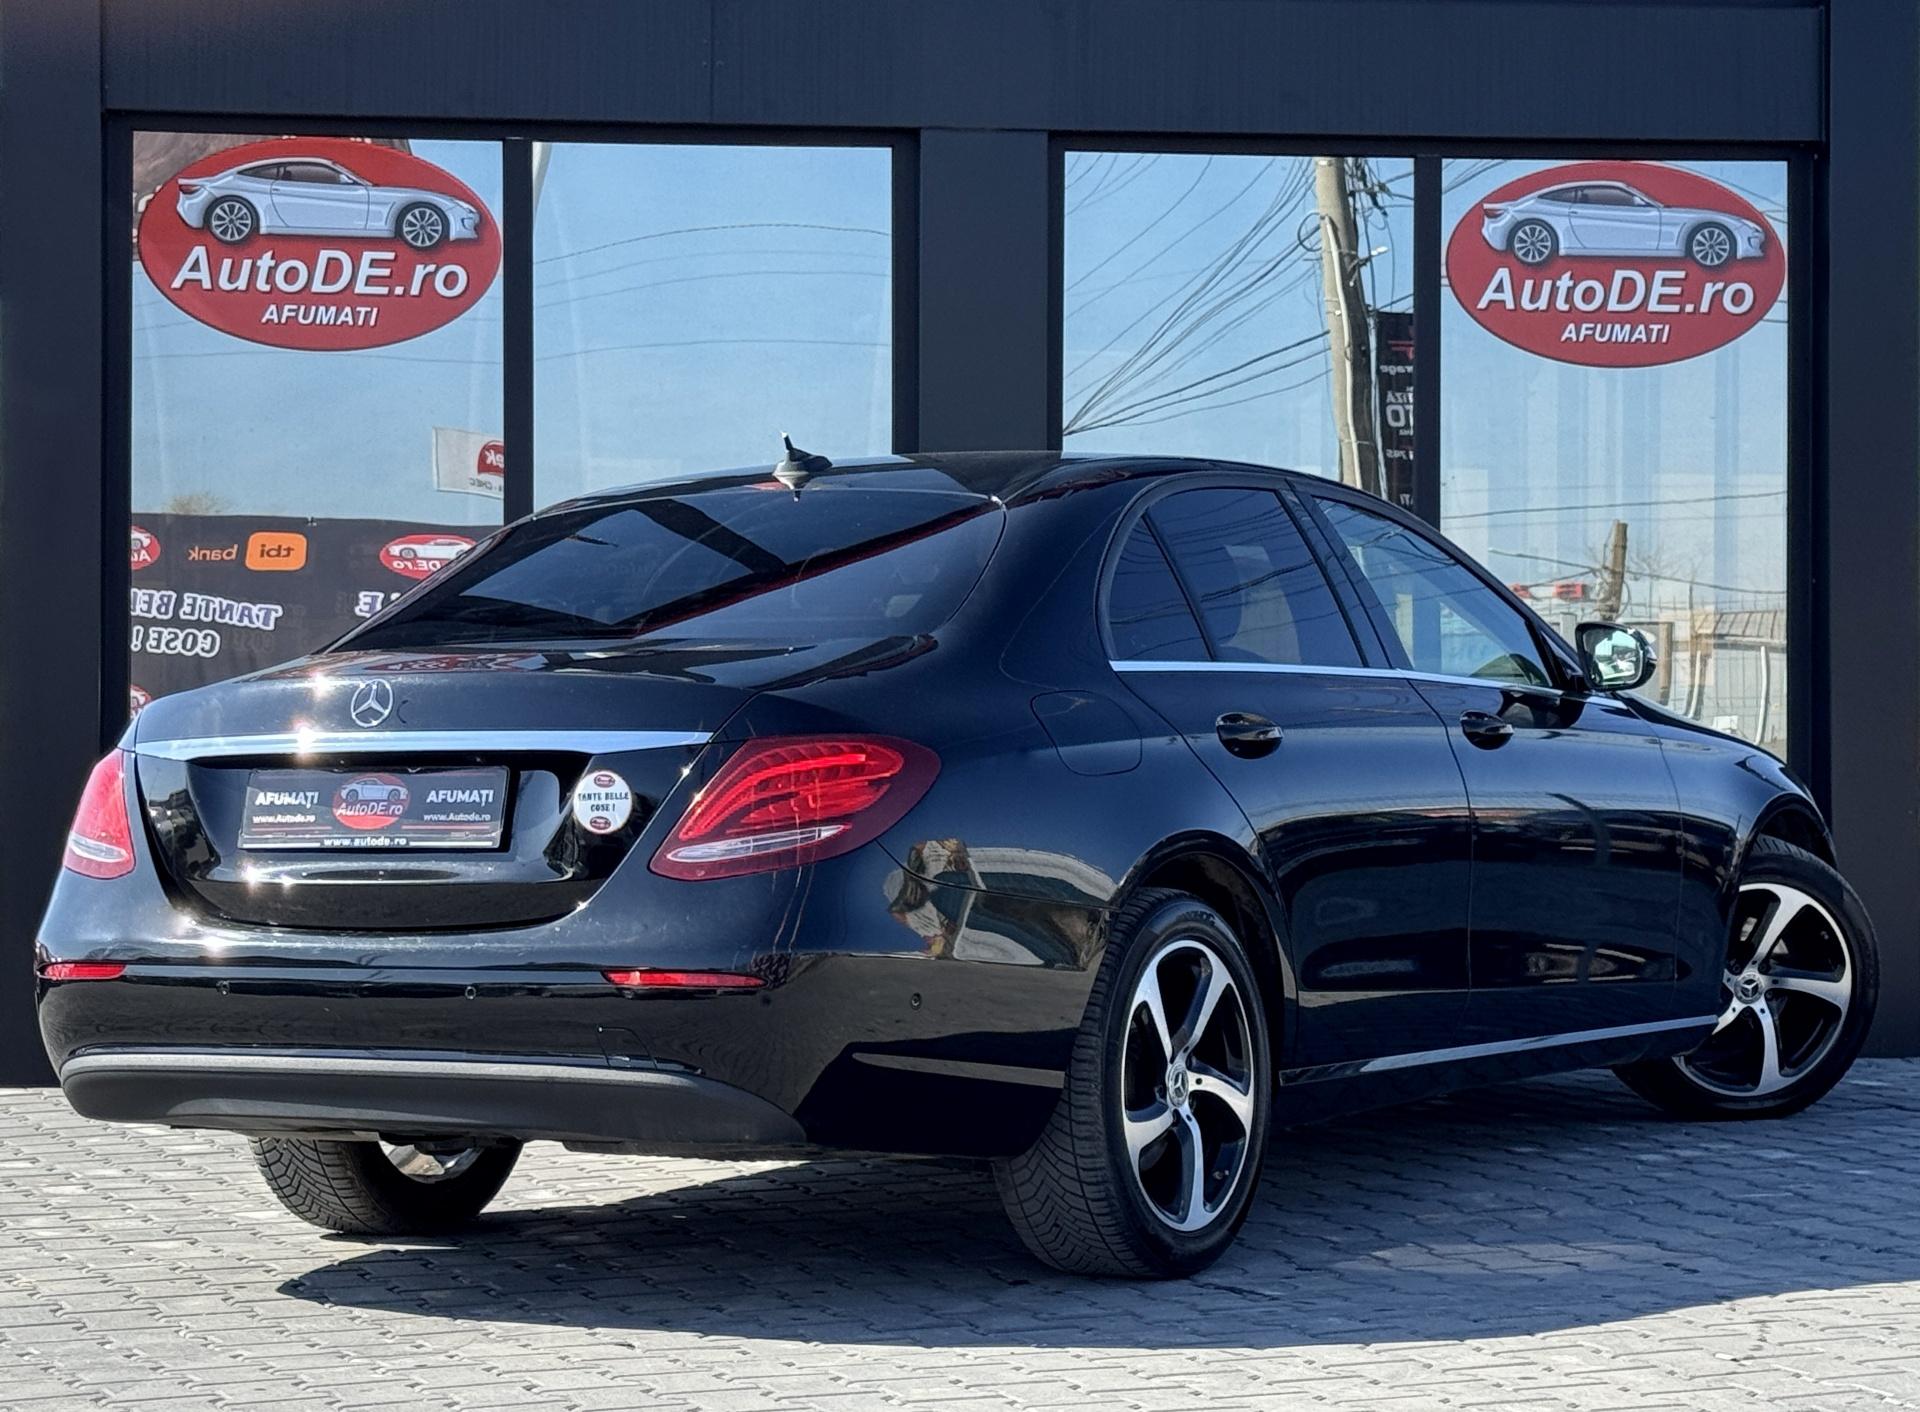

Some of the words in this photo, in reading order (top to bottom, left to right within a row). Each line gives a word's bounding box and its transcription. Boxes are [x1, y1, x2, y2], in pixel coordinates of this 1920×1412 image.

[171, 245, 469, 298] AutoDE.ro
[1477, 267, 1755, 315] AutoDE.ro
[261, 305, 378, 327] AFUMATI
[1560, 323, 1670, 344] AFUMATI
[605, 791, 630, 801] BELLE
[335, 802, 404, 817] AutoDE.ro
[590, 803, 610, 812] COSE
